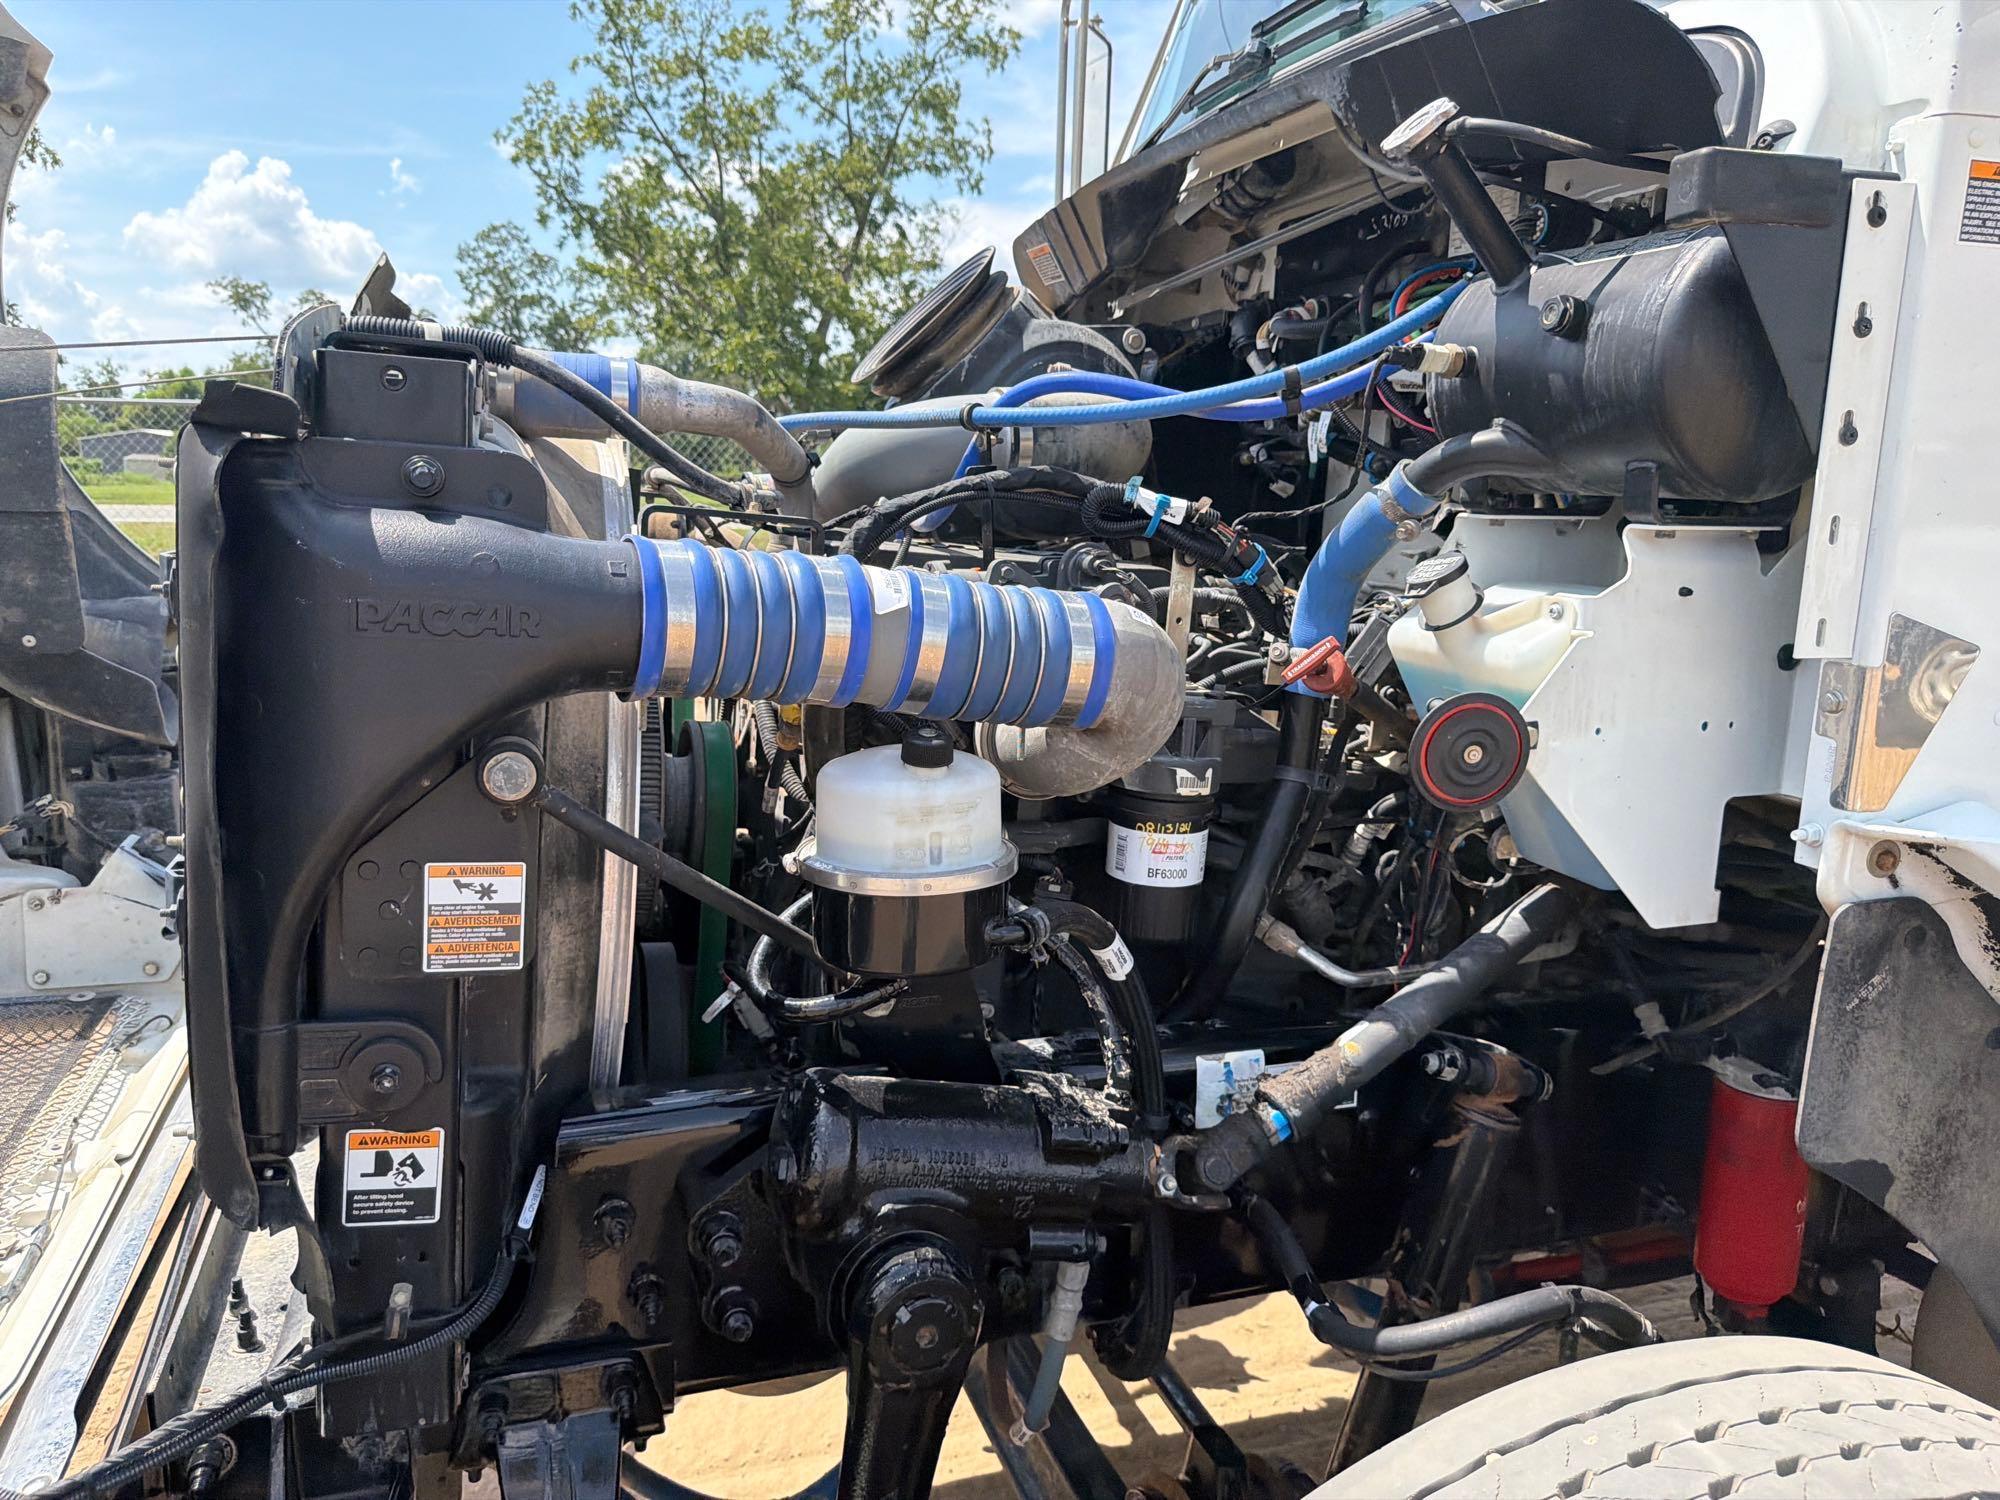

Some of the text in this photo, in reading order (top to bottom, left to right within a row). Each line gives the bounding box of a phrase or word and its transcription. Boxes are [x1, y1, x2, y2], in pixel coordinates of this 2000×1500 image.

[355, 599, 542, 638] PACCAR
[459, 867, 506, 876] WARNING
[1147, 867, 1188, 879] BF63000
[444, 916, 519, 926] AVERTISSEMENT
[448, 943, 514, 953] ADVERTENCIA
[369, 1135, 431, 1146] WARNING
[536, 1178, 544, 1192] NOT
[528, 1193, 540, 1213] BEND
